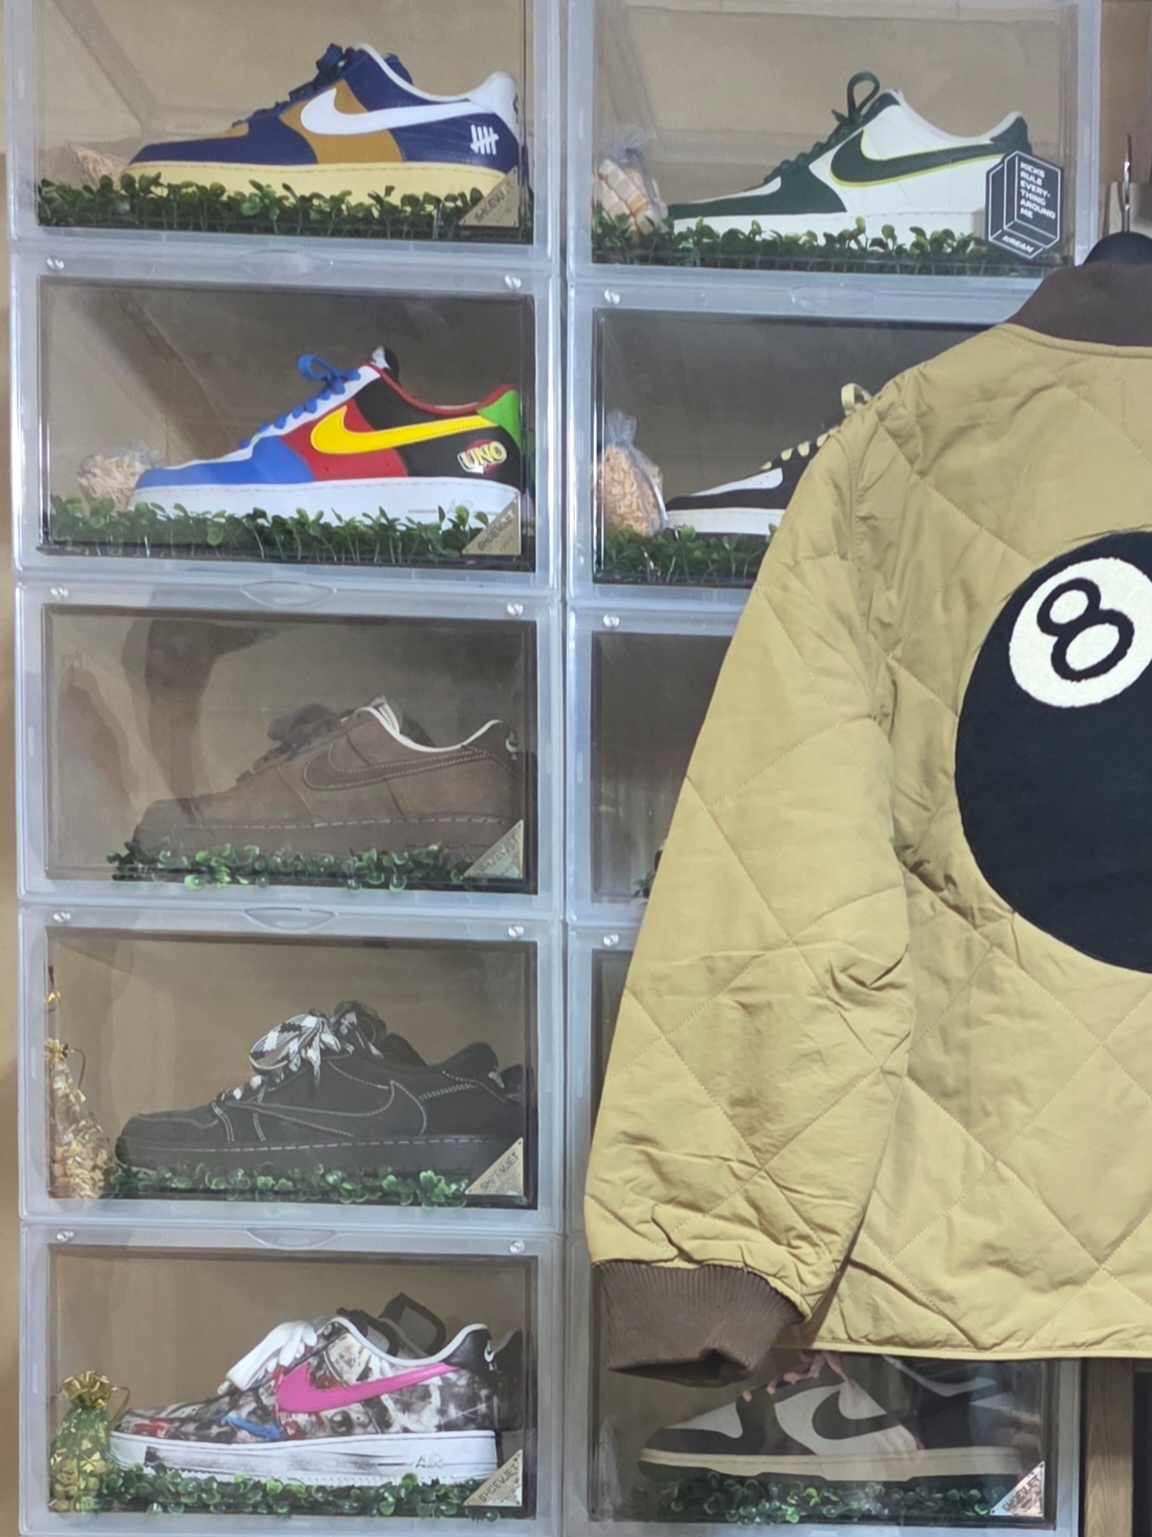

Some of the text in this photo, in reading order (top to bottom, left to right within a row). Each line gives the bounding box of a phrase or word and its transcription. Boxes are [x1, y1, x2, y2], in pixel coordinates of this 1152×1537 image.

[1020, 170, 1043, 186] RULE
[1020, 189, 1046, 206] THING
[1020, 199, 1056, 219] AROUND
[1020, 207, 1034, 219] ME
[459, 441, 507, 469] UNO
[1035, 577, 1135, 683] 8
